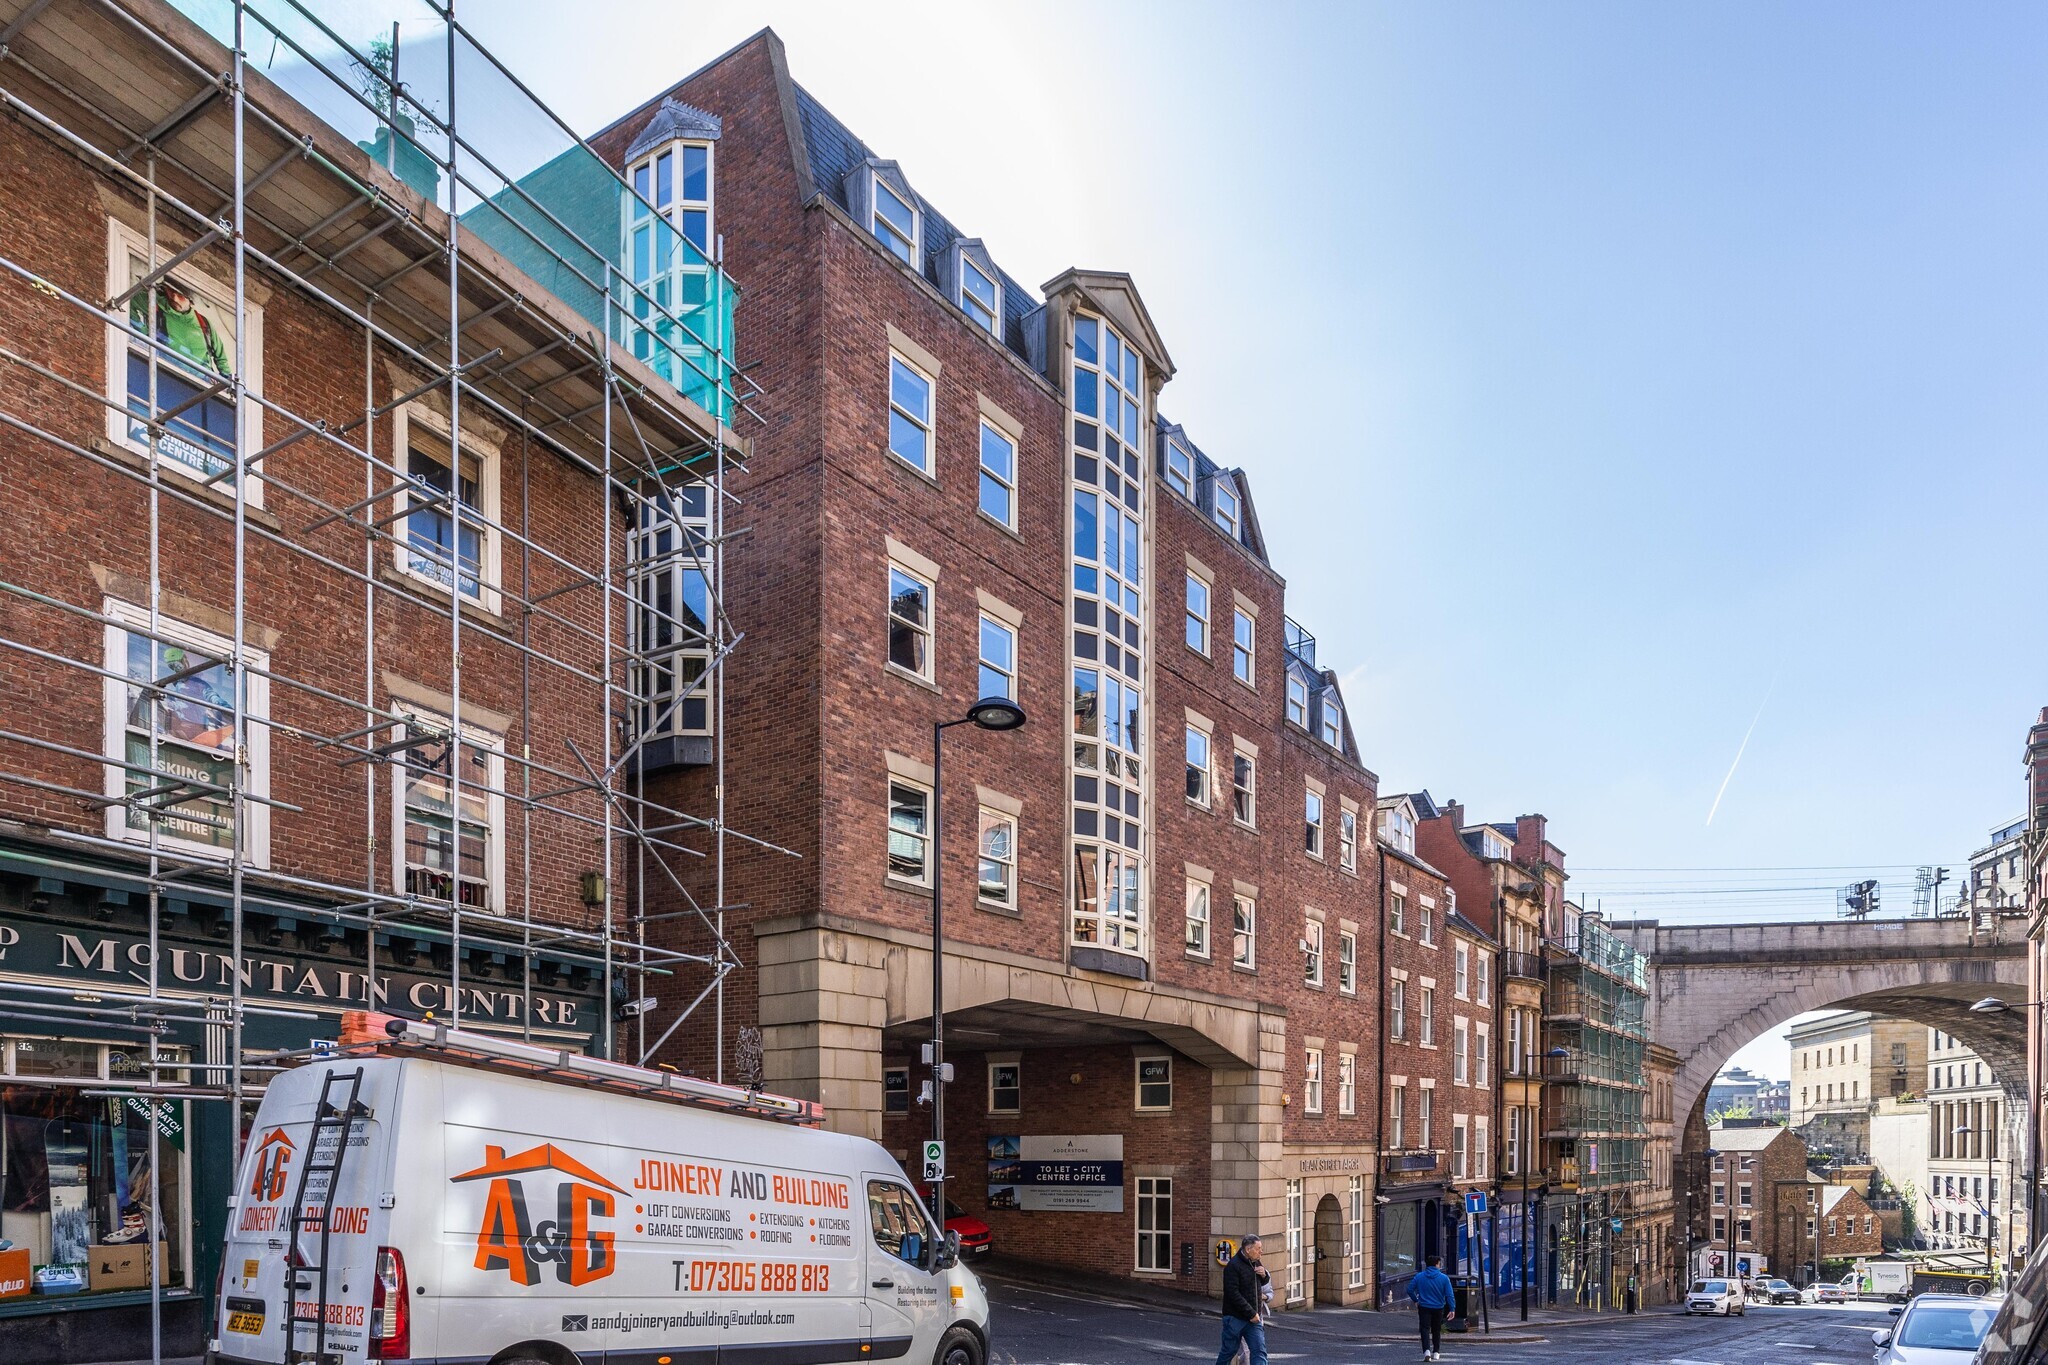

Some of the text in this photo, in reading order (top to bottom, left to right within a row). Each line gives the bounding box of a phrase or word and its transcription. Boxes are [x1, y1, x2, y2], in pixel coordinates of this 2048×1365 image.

[158, 438, 204, 470] CENTRE
[158, 760, 210, 783] SKIING
[160, 814, 209, 836] CENTRE
[56, 933, 391, 1005] MOUNTAIN
[409, 981, 578, 1026] CENTRE
[887, 1076, 903, 1085] GFW
[996, 1072, 1013, 1081] GFW
[1145, 1067, 1164, 1076] GFW
[127, 1098, 174, 1138] GUARTEE
[157, 1109, 183, 1133] MATCH
[1040, 1165, 1052, 1173] TO
[1055, 1165, 1071, 1173] LET
[1081, 1165, 1102, 1173] CITY
[1301, 1158, 1359, 1172] DEAN STREET ARCH
[634, 1159, 849, 1210] JOINERY AND BUILDING
[1036, 1173, 1106, 1182] CENTRE OFFICE
[240, 1206, 279, 1232] JOINERY
[647, 1203, 731, 1223] LOFT CONVERSIONS
[760, 1212, 804, 1228] EXTENSIONS
[474, 1177, 616, 1288] A&G
[647, 1222, 744, 1242] GARAGE CONVERSIONS
[818, 1217, 850, 1231] KITCHENS
[760, 1230, 792, 1244] ROOFING
[819, 1233, 851, 1247] FLOORING
[761, 1263, 797, 1292] 888
[801, 1264, 830, 1292] 813
[1877, 1271, 1900, 1280] Tyneside
[897, 1285, 938, 1296] Building the future
[897, 1297, 937, 1308] Restoring the past
[345, 1305, 365, 1327] 813
[591, 1309, 796, 1333] aandgjoineryandbuilding@outlook.com
[328, 1342, 360, 1353] RENAULT
